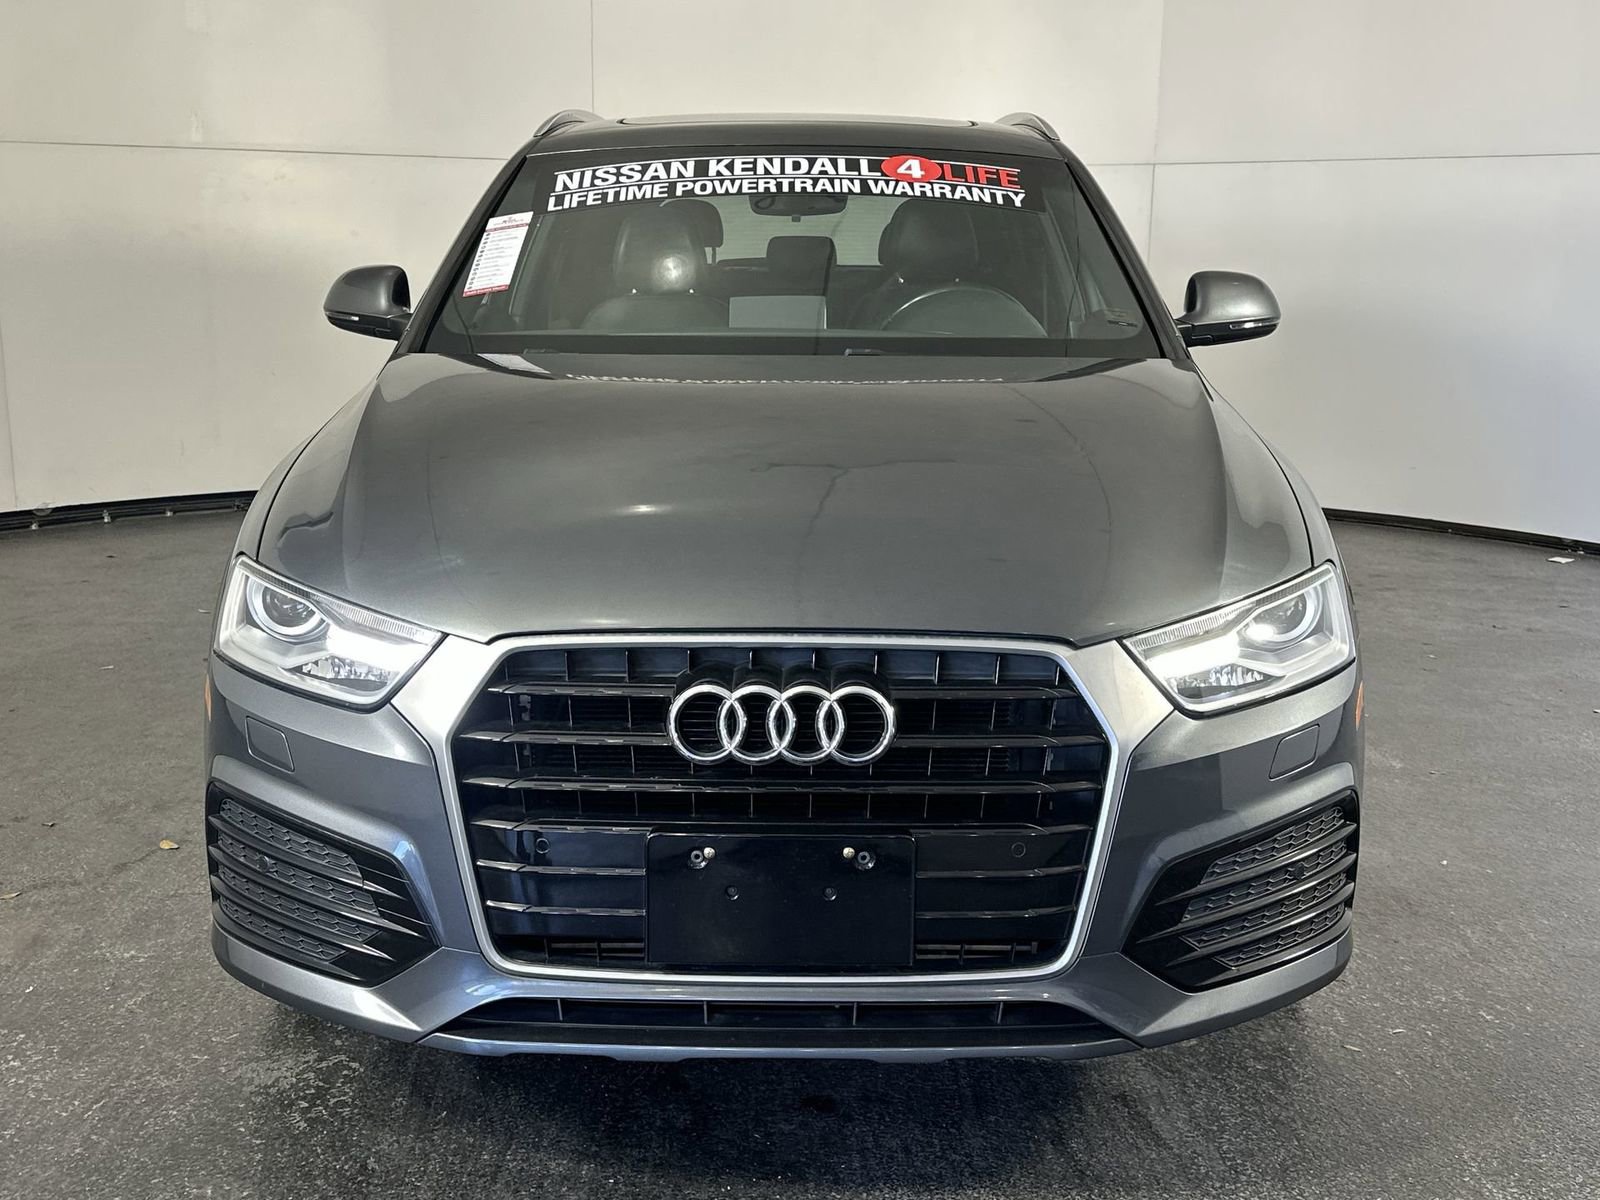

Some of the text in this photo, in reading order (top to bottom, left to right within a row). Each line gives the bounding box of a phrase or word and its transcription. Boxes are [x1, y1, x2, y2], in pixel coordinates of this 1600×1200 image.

[554, 157, 1021, 192] NISSAN KENDALL 4 LIFE
[547, 178, 1026, 212] LIFETIME POWERTRAIN WARRANTY
